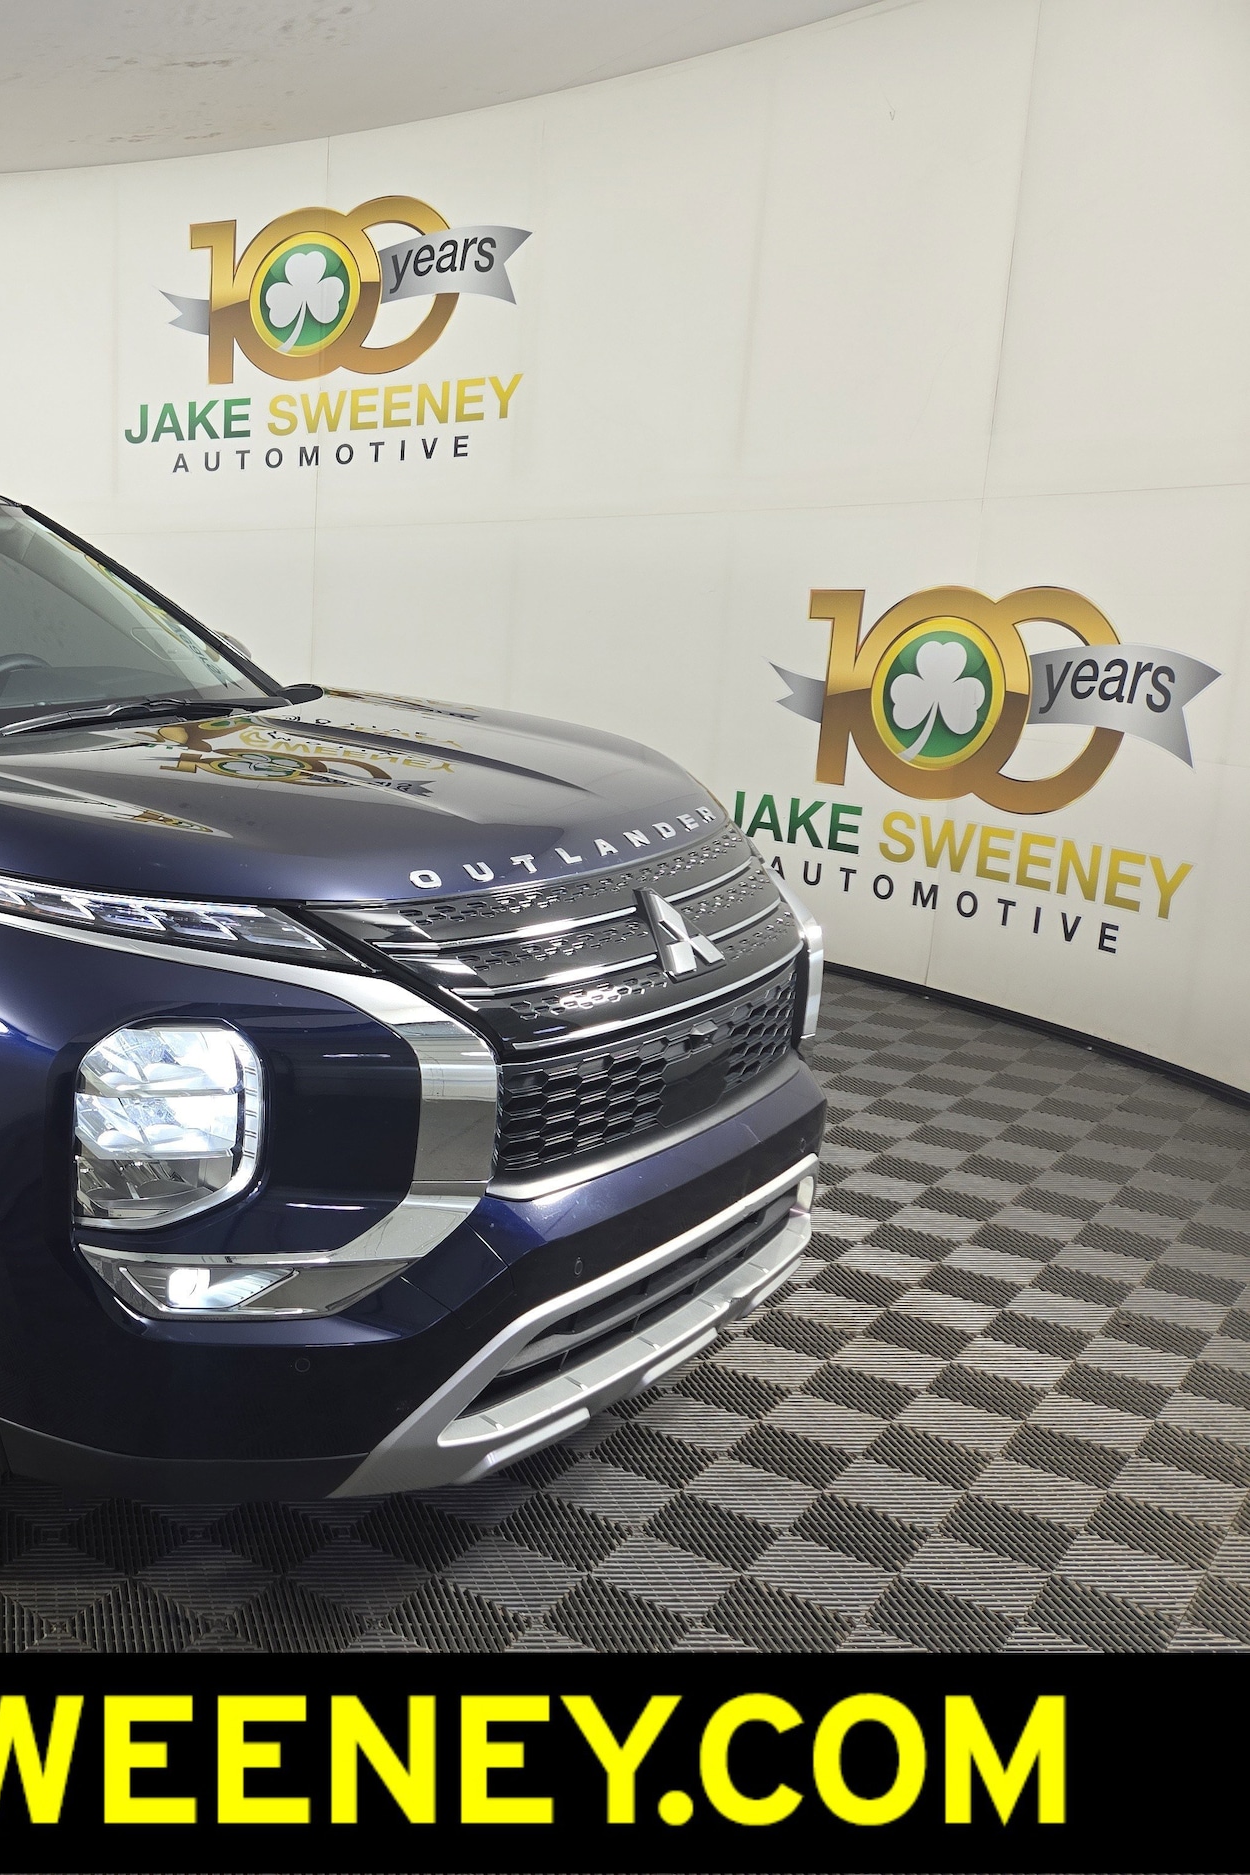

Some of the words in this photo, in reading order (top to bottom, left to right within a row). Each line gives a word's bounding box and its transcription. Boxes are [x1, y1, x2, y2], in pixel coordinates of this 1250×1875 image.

[389, 236, 497, 294] years
[124, 397, 251, 444] JAKE
[267, 373, 524, 437] SWEENEY
[172, 435, 470, 473] AUTOMOTIVE
[1038, 658, 1175, 714] years
[409, 805, 717, 889] OUTLANDER
[879, 810, 1196, 921] SWEENEY
[770, 856, 1120, 954] AUTOMOTIVE
